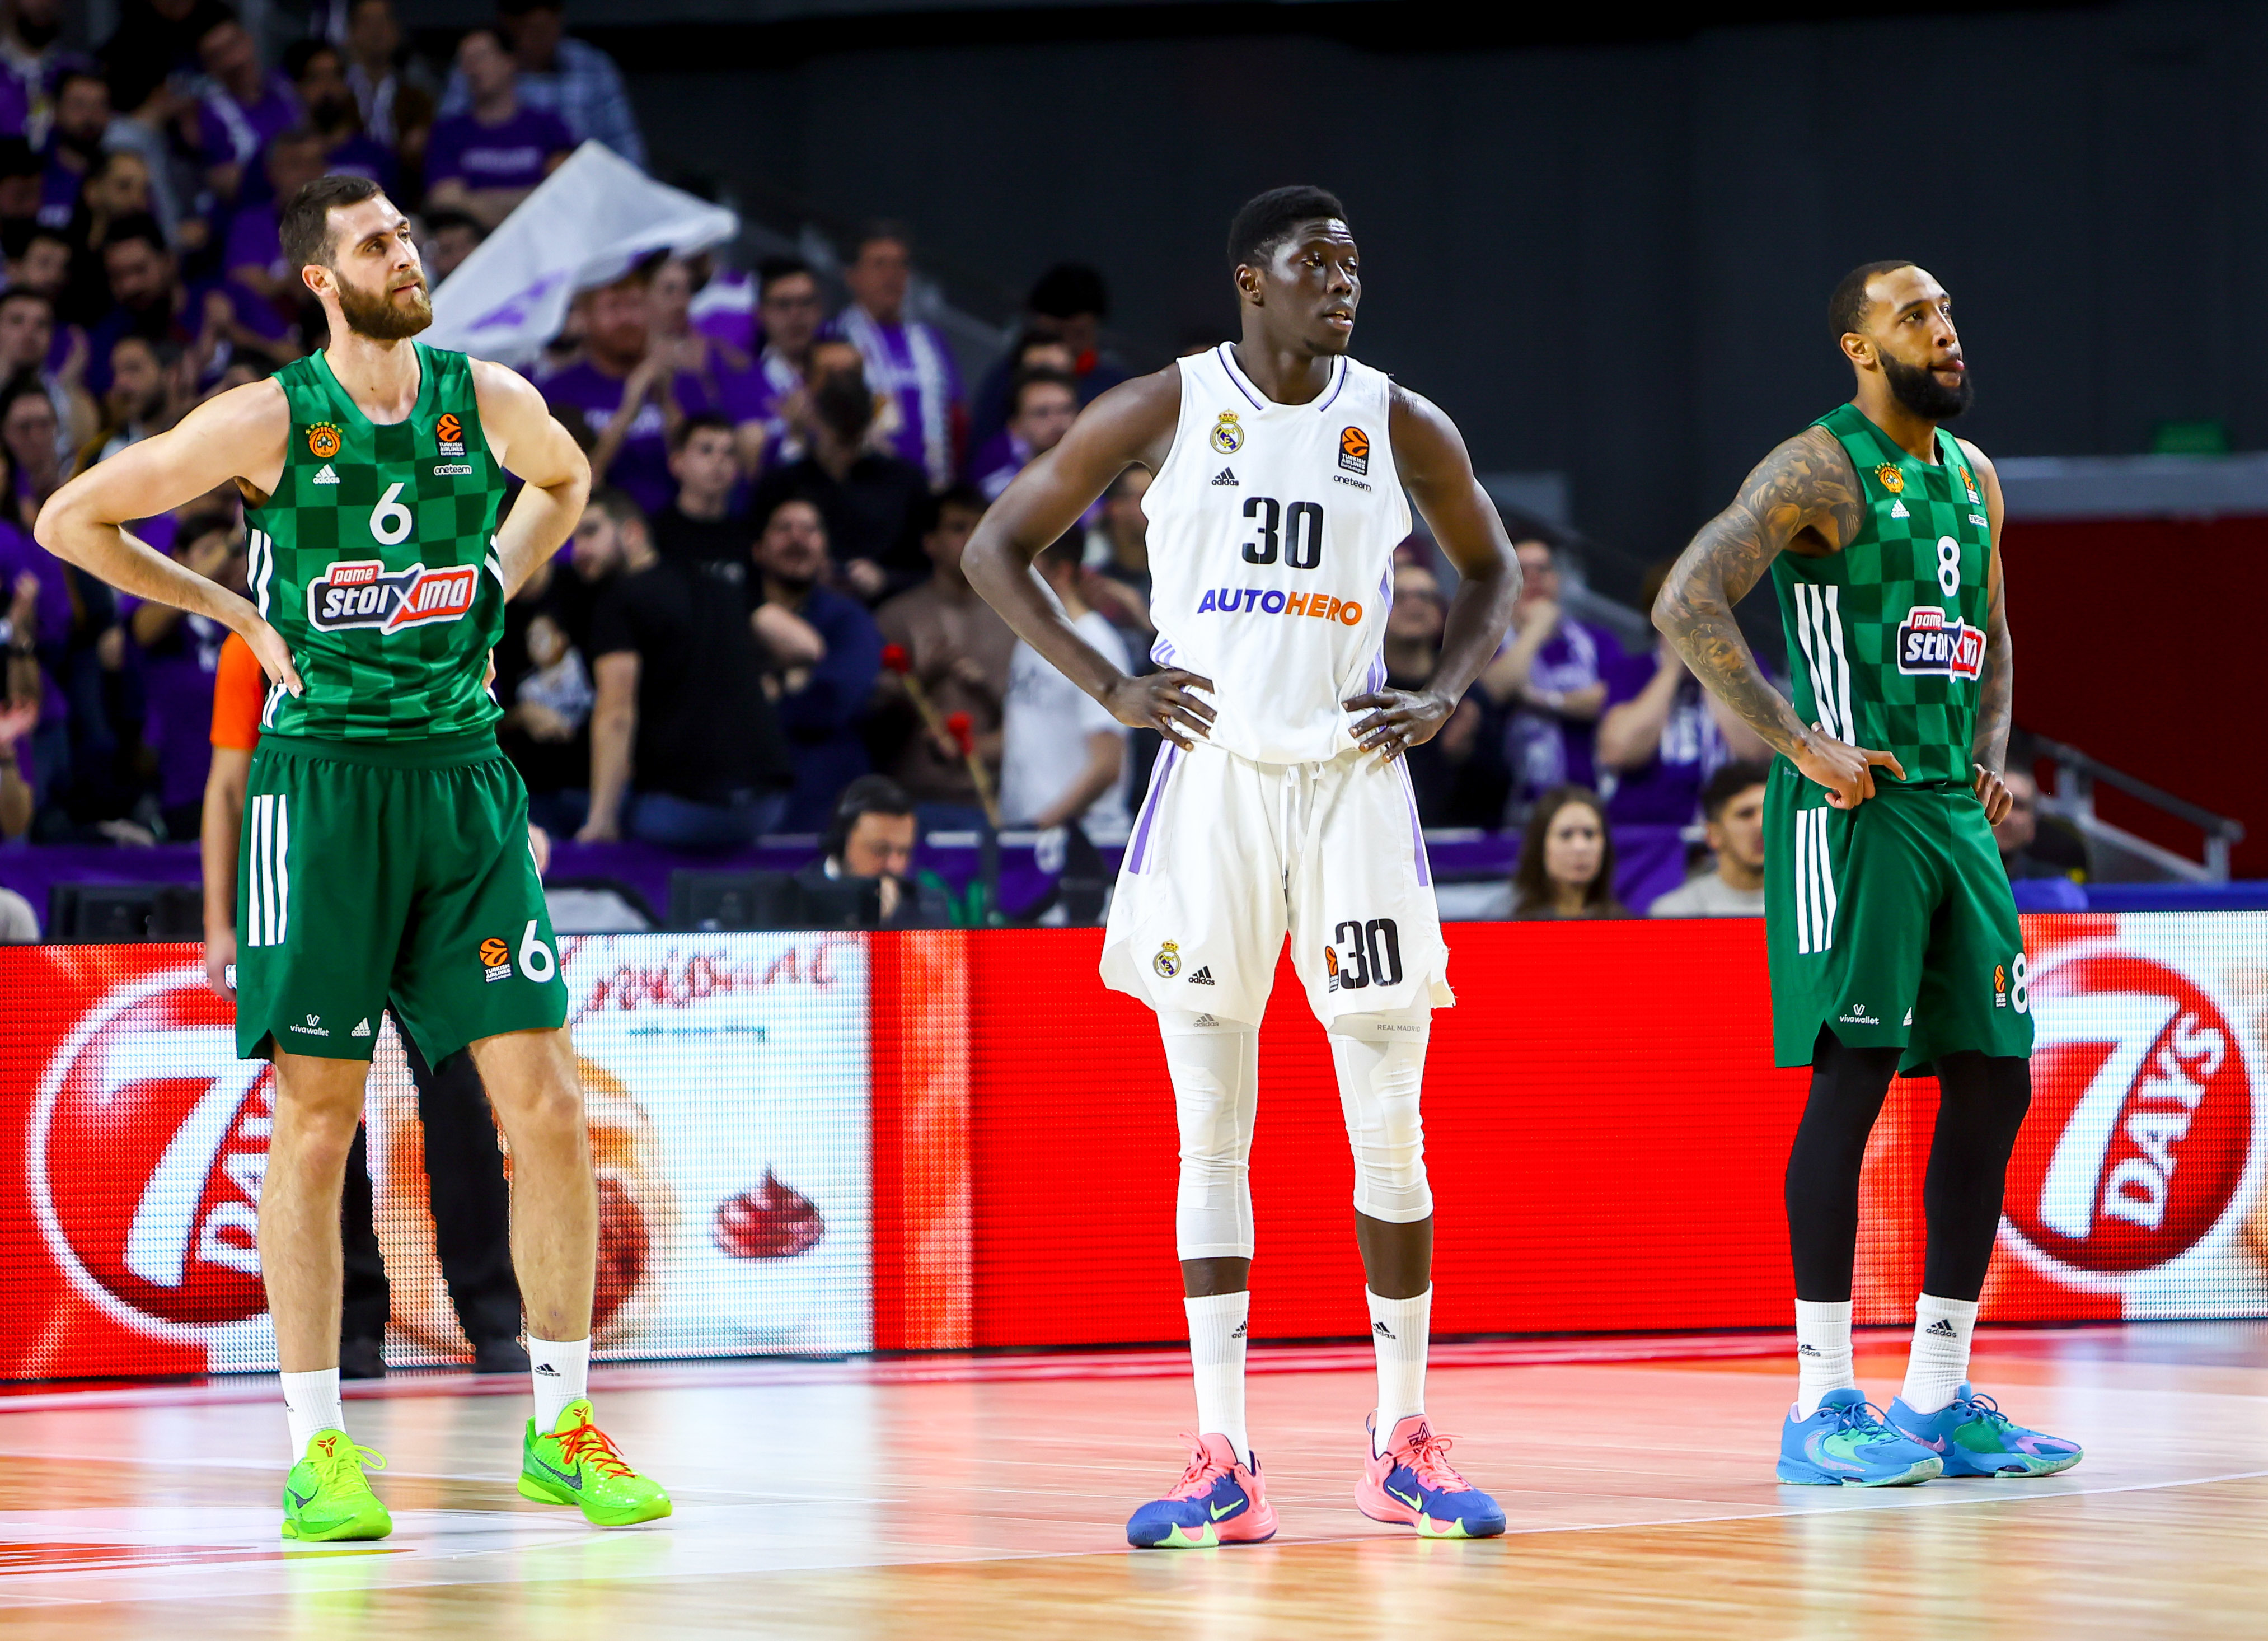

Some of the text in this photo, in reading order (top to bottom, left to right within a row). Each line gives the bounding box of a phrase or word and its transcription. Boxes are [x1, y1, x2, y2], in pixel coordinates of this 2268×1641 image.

[434, 465, 471, 474] oneteam
[1341, 458, 1365, 469] AIRLINES
[1342, 453, 1366, 464] TURKISH
[1333, 475, 1372, 492] oneteam
[369, 483, 412, 545] 6
[1242, 497, 1323, 569] 30
[334, 568, 373, 585] pame
[1937, 535, 1960, 597] 8
[1197, 588, 1363, 626] AUTOHERO
[518, 920, 555, 983] 6
[1335, 918, 1403, 989] 30
[485, 964, 510, 974] TURKISH
[486, 969, 512, 978] AIRLINES
[1188, 976, 1215, 985] adidas
[2011, 952, 2029, 1014] 8
[2026, 994, 2228, 1240] 7 DAYS
[101, 1023, 271, 1288] 7
[1926, 1327, 1957, 1338] adidas
